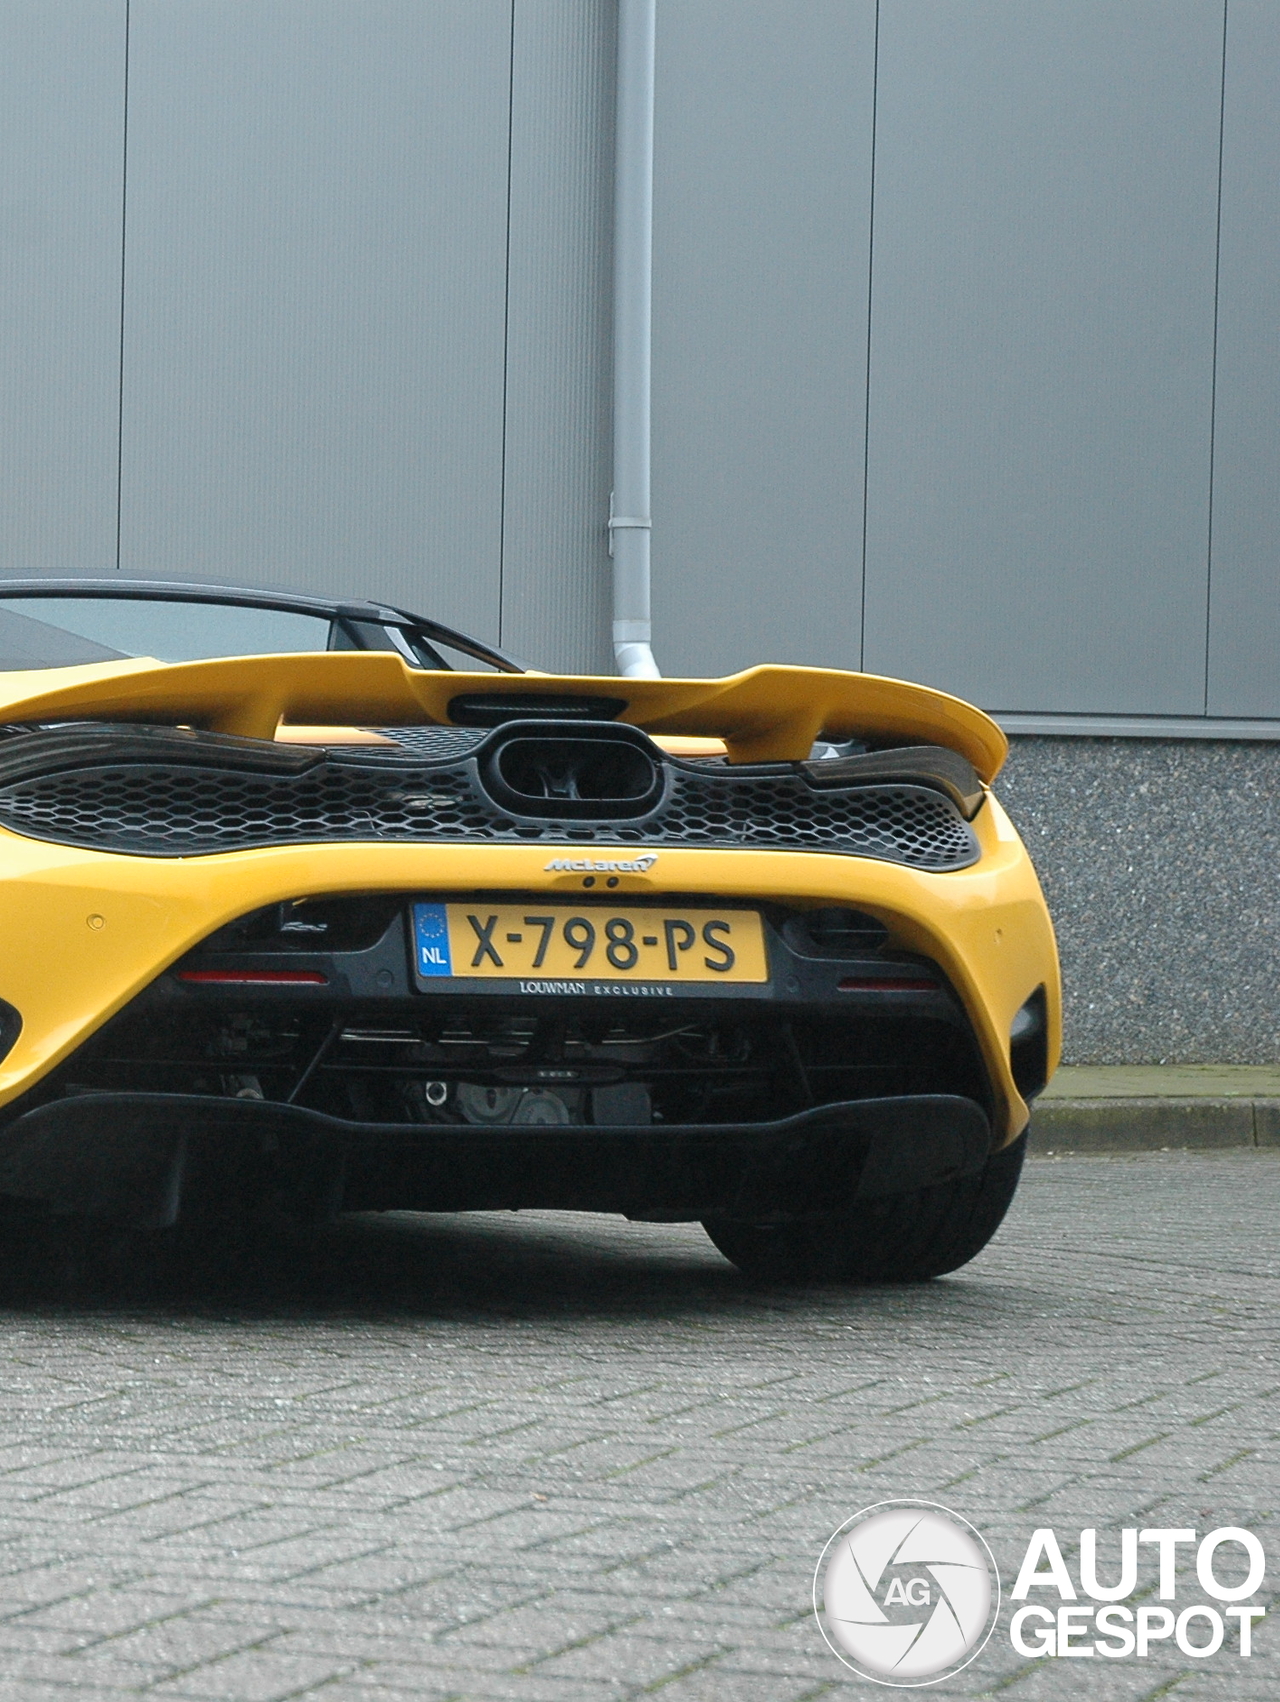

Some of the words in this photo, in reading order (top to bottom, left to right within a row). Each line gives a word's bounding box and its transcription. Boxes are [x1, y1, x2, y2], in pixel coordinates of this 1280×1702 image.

[543, 858, 648, 872] McLaren
[467, 915, 735, 971] X-798-PS
[422, 947, 447, 964] NL
[520, 981, 586, 994] LOUWMAN
[593, 985, 674, 996] EXCLUSIVE
